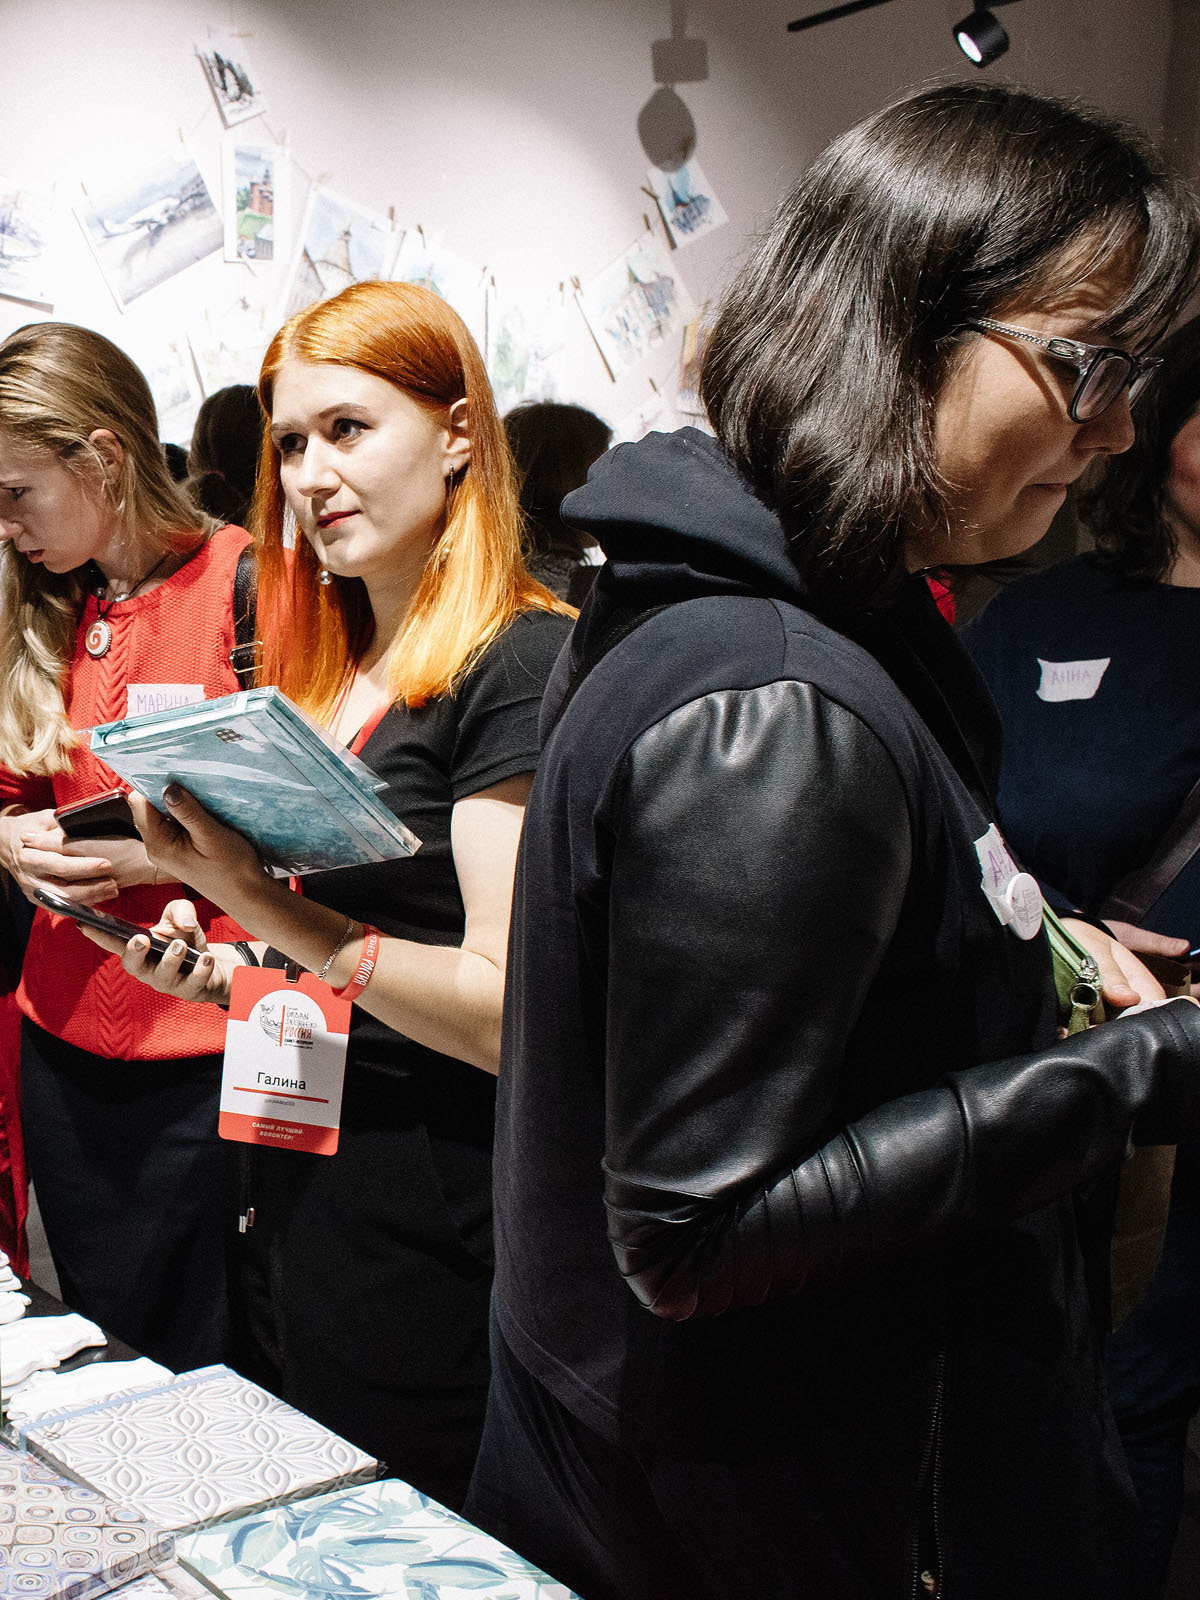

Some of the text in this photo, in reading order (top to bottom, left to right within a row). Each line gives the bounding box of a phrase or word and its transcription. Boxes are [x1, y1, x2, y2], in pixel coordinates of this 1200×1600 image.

[353, 958, 374, 986] РОССИЯ
[284, 1026, 312, 1040] РОССИЯ
[257, 1071, 306, 1090] Галина
